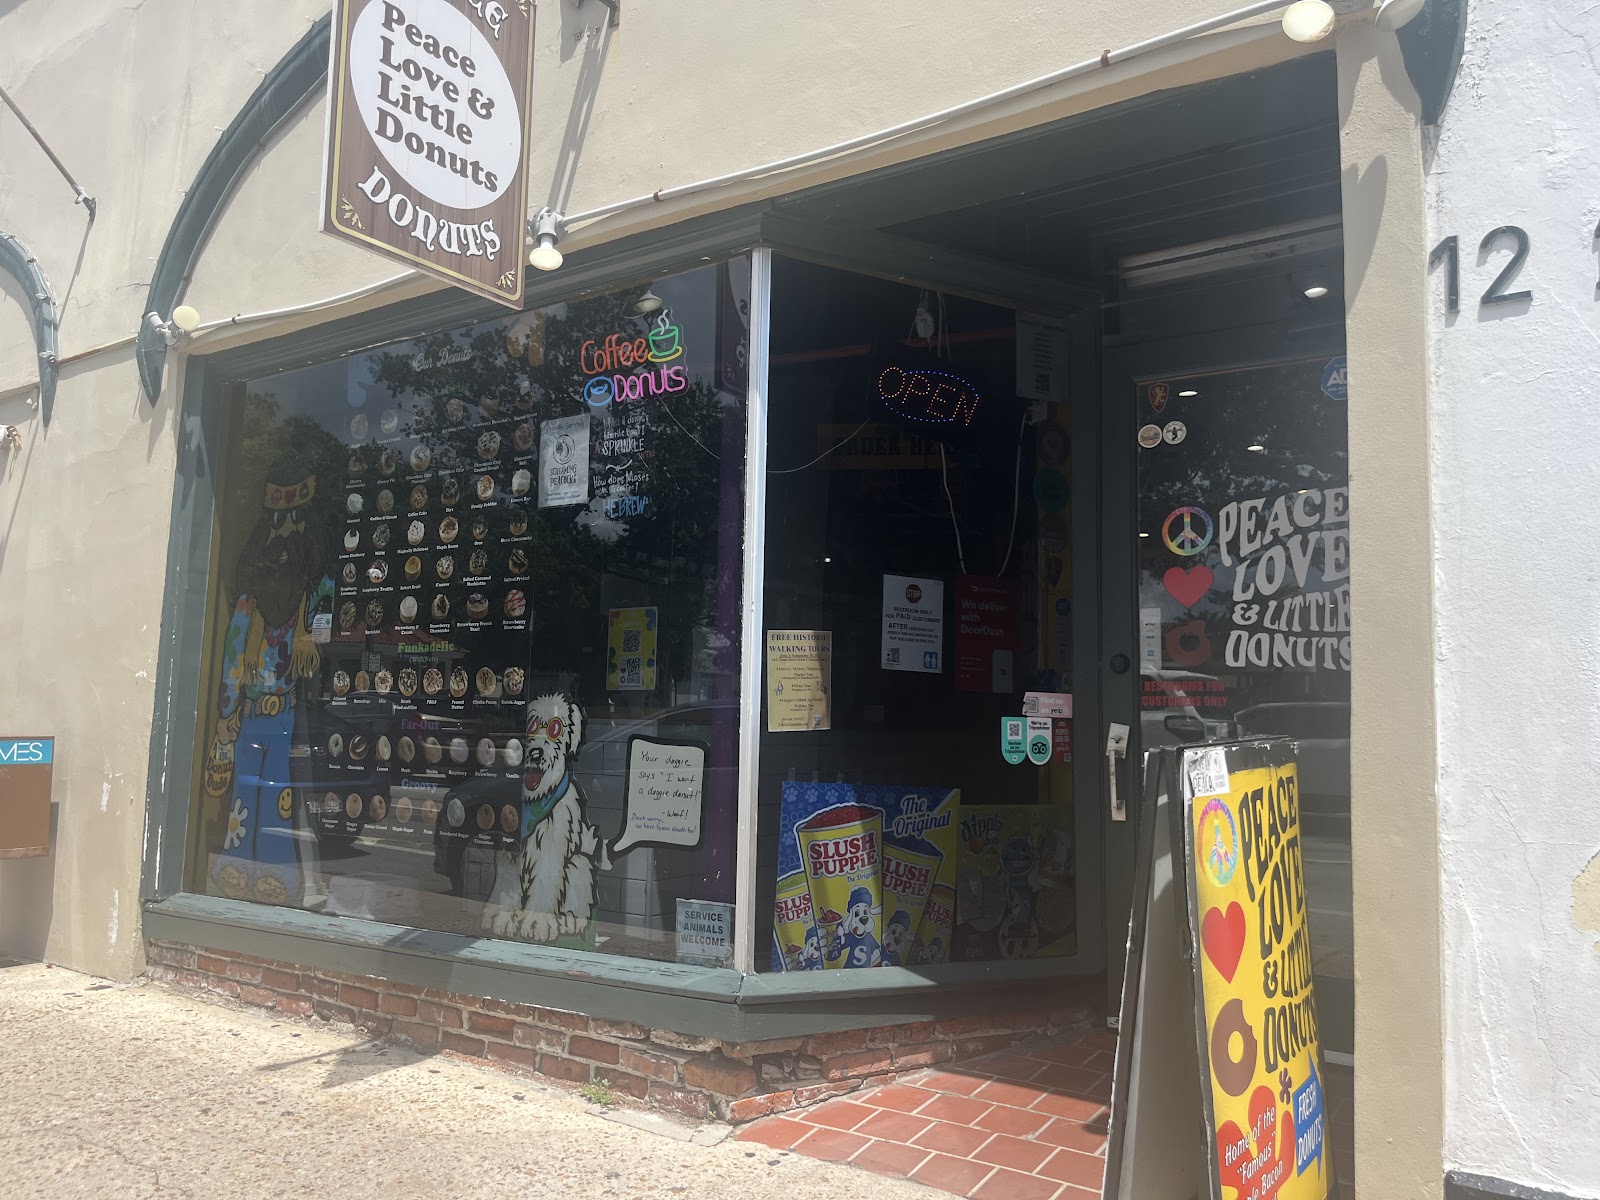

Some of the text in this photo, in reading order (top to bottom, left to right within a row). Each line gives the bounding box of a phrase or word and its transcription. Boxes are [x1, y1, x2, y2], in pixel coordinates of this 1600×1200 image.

[381, 0, 476, 78] Peace
[379, 35, 495, 120] Love &
[377, 71, 473, 145] Little
[375, 107, 498, 193] Donuts
[358, 165, 501, 261] DONUTS
[581, 334, 649, 375] Coffee
[614, 364, 686, 402] Donuts
[879, 366, 979, 426] OPEN
[1218, 488, 1349, 567] PEACE
[1232, 528, 1349, 602] LOVE
[907, 589, 920, 598] STOP
[961, 600, 1008, 612] We deliver
[1232, 583, 1350, 632] & LITTLE
[894, 606, 918, 614] RESTROOM
[896, 612, 911, 620] PAID
[961, 613, 980, 623] with
[888, 622, 908, 630] AFTER
[960, 624, 1004, 637] DoorDash
[397, 640, 456, 653] Funkadelic
[808, 645, 830, 653] TOURS
[1225, 629, 1351, 672] DONUTS
[401, 719, 440, 730] Far-Out
[641, 751, 692, 768] Your doggie
[401, 778, 439, 794] Groovy
[638, 771, 655, 782] says
[678, 775, 696, 783] want
[648, 786, 669, 801] doggie
[902, 796, 928, 815] The
[894, 809, 952, 839] Original
[810, 832, 877, 861] SLUSH
[1239, 775, 1298, 903] PEACE
[775, 893, 812, 912] SLUS
[1259, 832, 1305, 960] LOVE
[683, 922, 724, 935] ANIMALS
[684, 910, 723, 922] SERVICE
[777, 905, 812, 924] PUPP
[680, 933, 725, 947] WELCOME
[1263, 960, 1278, 998] &
[1298, 1080, 1318, 1125] FRESH
[1225, 1106, 1276, 1167] Home of the
[1298, 1114, 1323, 1167] DONUTS
[1261, 1160, 1284, 1196] Bacon
